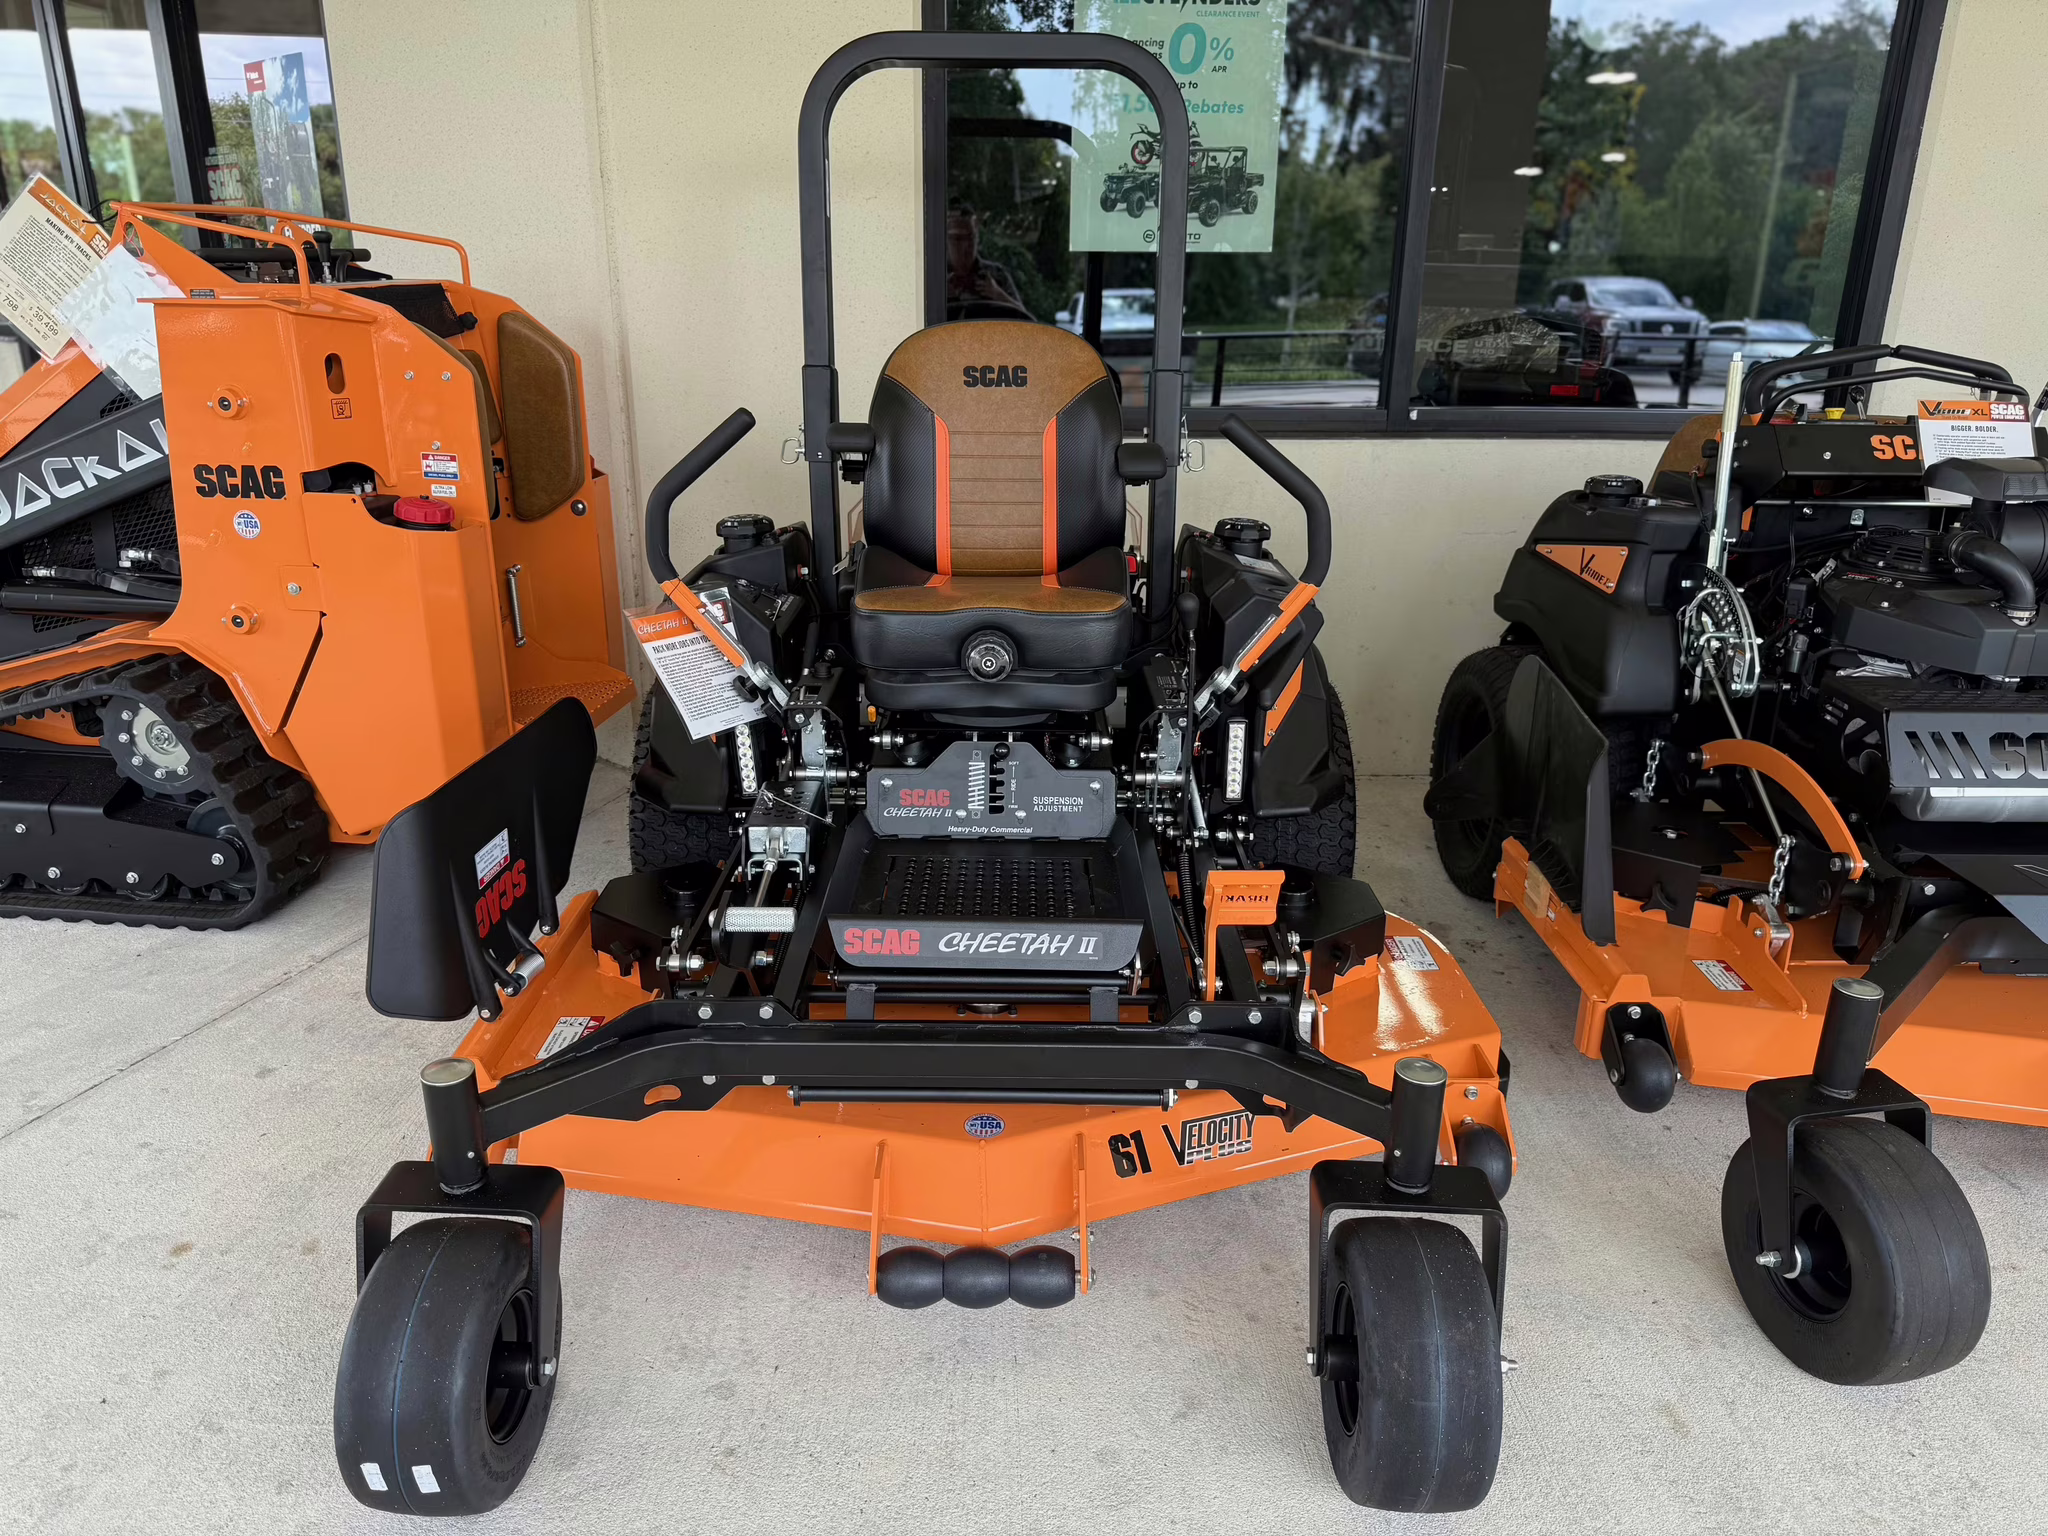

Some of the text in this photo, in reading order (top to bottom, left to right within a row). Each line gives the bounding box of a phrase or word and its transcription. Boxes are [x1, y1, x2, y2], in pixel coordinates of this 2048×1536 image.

[1196, 10, 1237, 18] CLEARANCE
[1132, 37, 1165, 50] ancing
[1211, 65, 1228, 73] APR
[1188, 80, 1199, 89] to
[1185, 98, 1244, 114] Rebates
[207, 168, 243, 200] SCAG
[39, 193, 87, 235] JACKAL
[45, 217, 67, 236] MAKING
[64, 233, 76, 245] NEW
[74, 242, 92, 262] TRACKS.
[92, 233, 108, 254] SC
[3, 295, 19, 312] 798
[32, 310, 59, 337] 39,499
[962, 365, 1028, 387] SCAG
[1971, 408, 1988, 416] XL
[1990, 403, 2025, 416] SCAG
[1951, 424, 1999, 433] BIGGER. BOLDER.
[1870, 434, 1917, 460] SC
[193, 463, 286, 499] SCAG
[243, 520, 259, 529] USA
[638, 619, 680, 635] CHEETAH
[652, 635, 712, 655] PACK MORE JOBS INTO YOU
[1989, 732, 2048, 779] SC
[900, 789, 951, 807] SCAG
[1032, 796, 1084, 806] SUSPENSION
[883, 807, 953, 818] CHEETAH II
[1033, 805, 1083, 813] ADJUSTMENT
[947, 825, 1033, 835] Heavy-Duty Commercial
[475, 858, 527, 939] SCAG
[843, 928, 1099, 957] SCAG CHEETAH II
[980, 1121, 1002, 1130] USA
[1108, 1108, 1256, 1178] 61 VELOCITY
[1186, 1140, 1252, 1165] PLUS
